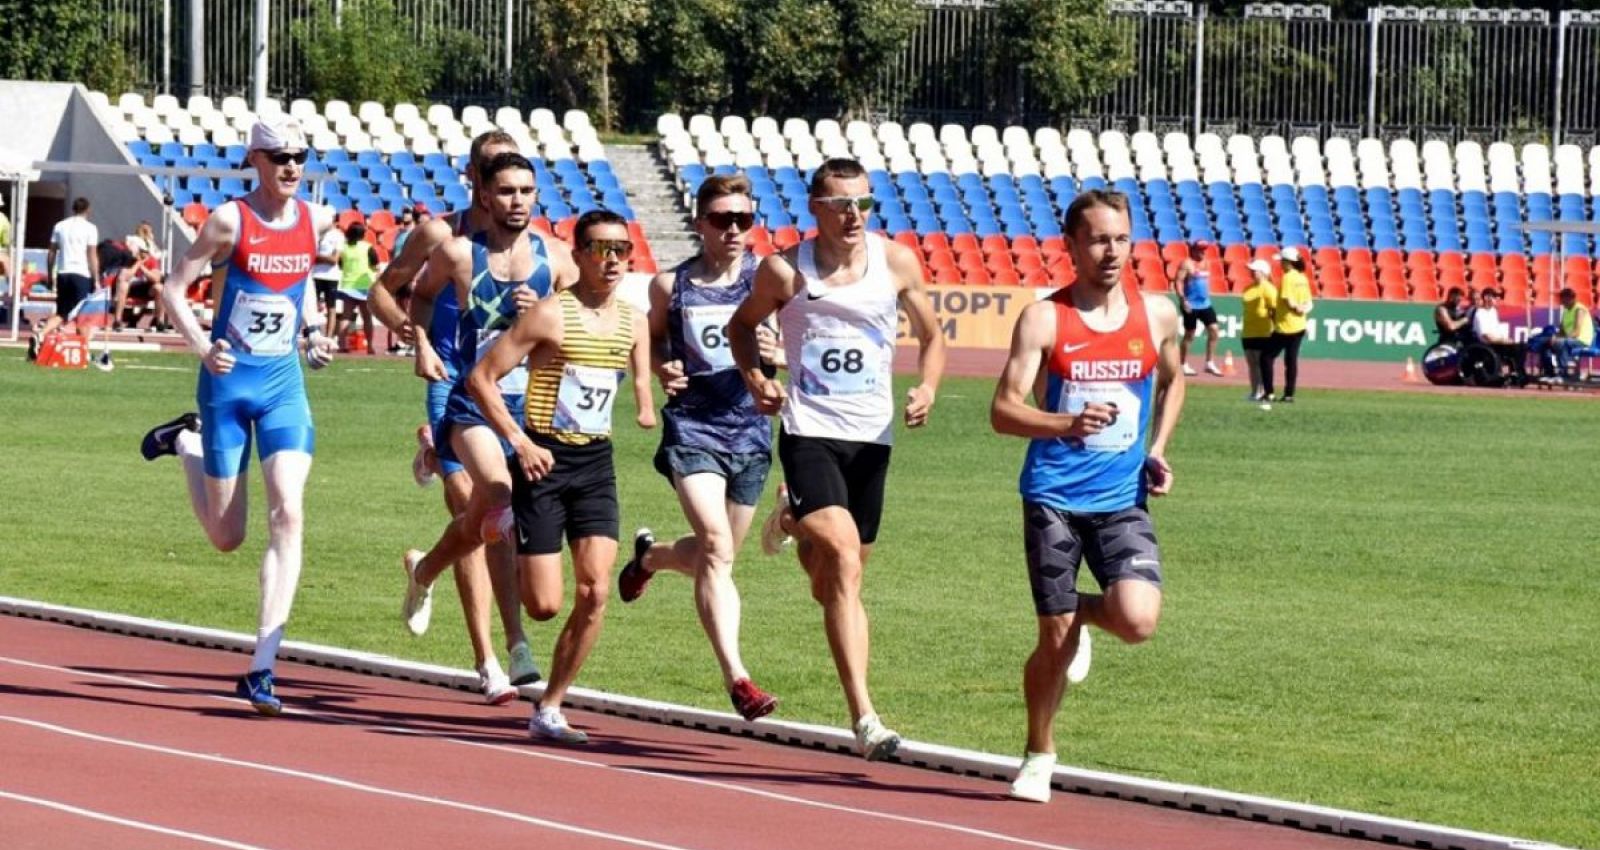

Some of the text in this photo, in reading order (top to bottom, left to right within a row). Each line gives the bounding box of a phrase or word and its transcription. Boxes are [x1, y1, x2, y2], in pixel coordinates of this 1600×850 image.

[248, 253, 311, 274] RUSSIA
[924, 290, 1012, 316] ПОРТ
[248, 308, 285, 334] 33
[1323, 318, 1427, 346] ТОЧКА
[63, 348, 81, 365] 18
[820, 348, 864, 374] 68
[1070, 360, 1142, 380] RUSSIA
[576, 384, 612, 412] 37
